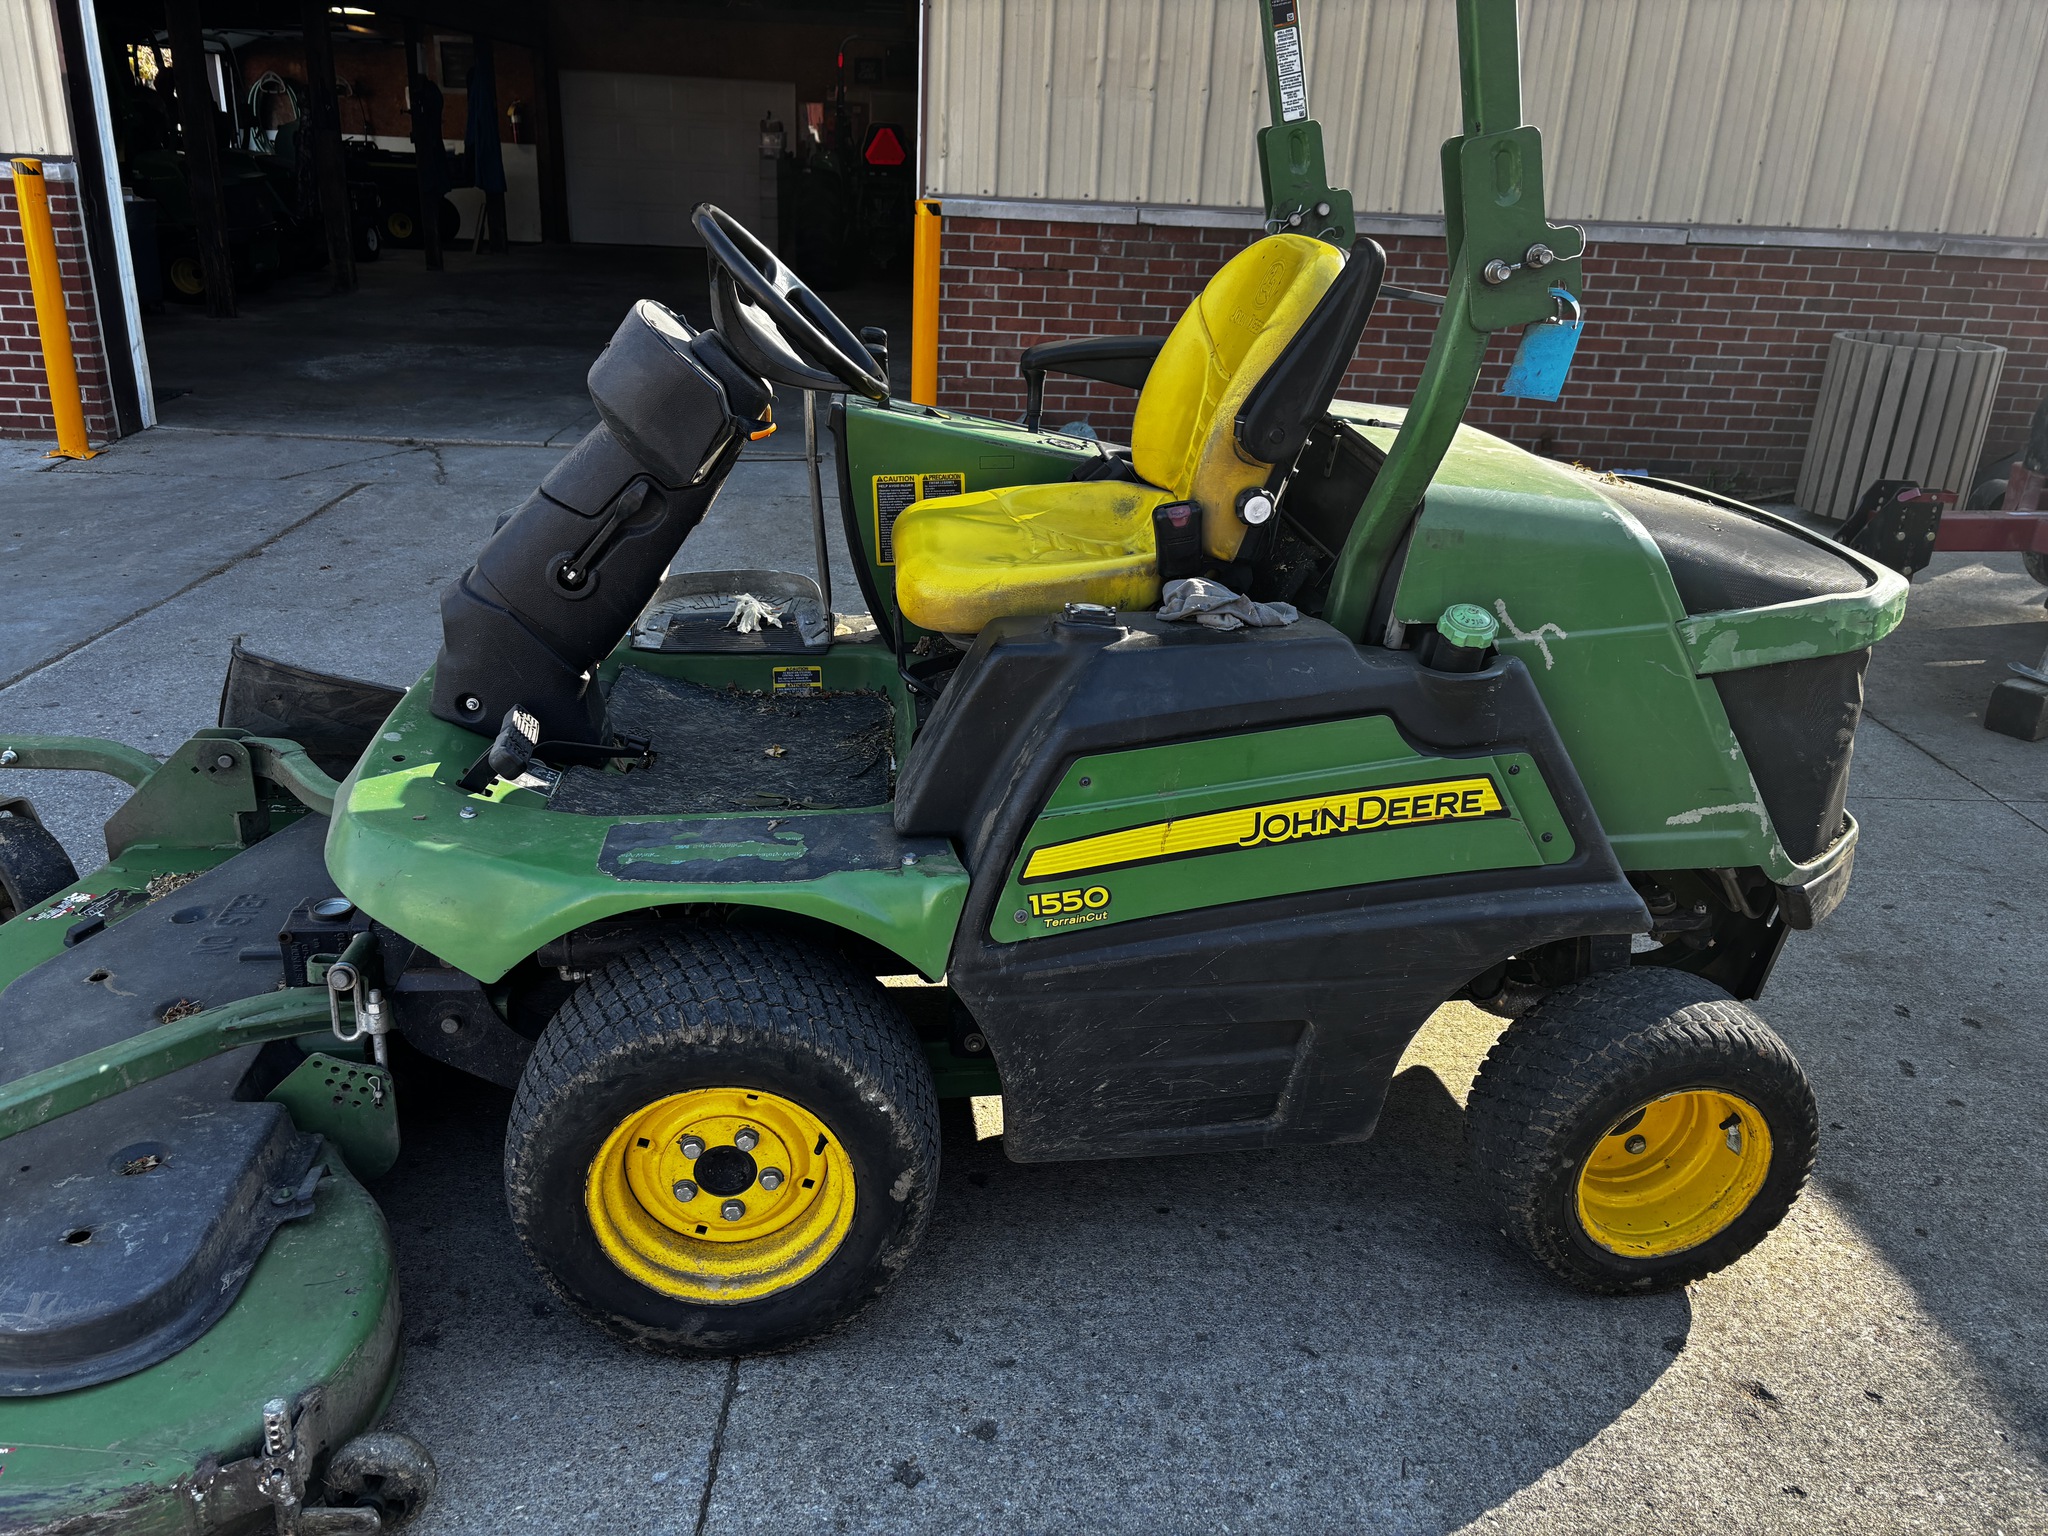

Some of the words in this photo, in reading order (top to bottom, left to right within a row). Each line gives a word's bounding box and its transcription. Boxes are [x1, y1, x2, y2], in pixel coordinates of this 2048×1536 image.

[1240, 806, 1346, 842] JOHN
[1357, 789, 1484, 825] DEERE
[1028, 886, 1109, 916] 1550
[1044, 911, 1108, 928] TerrainCut
